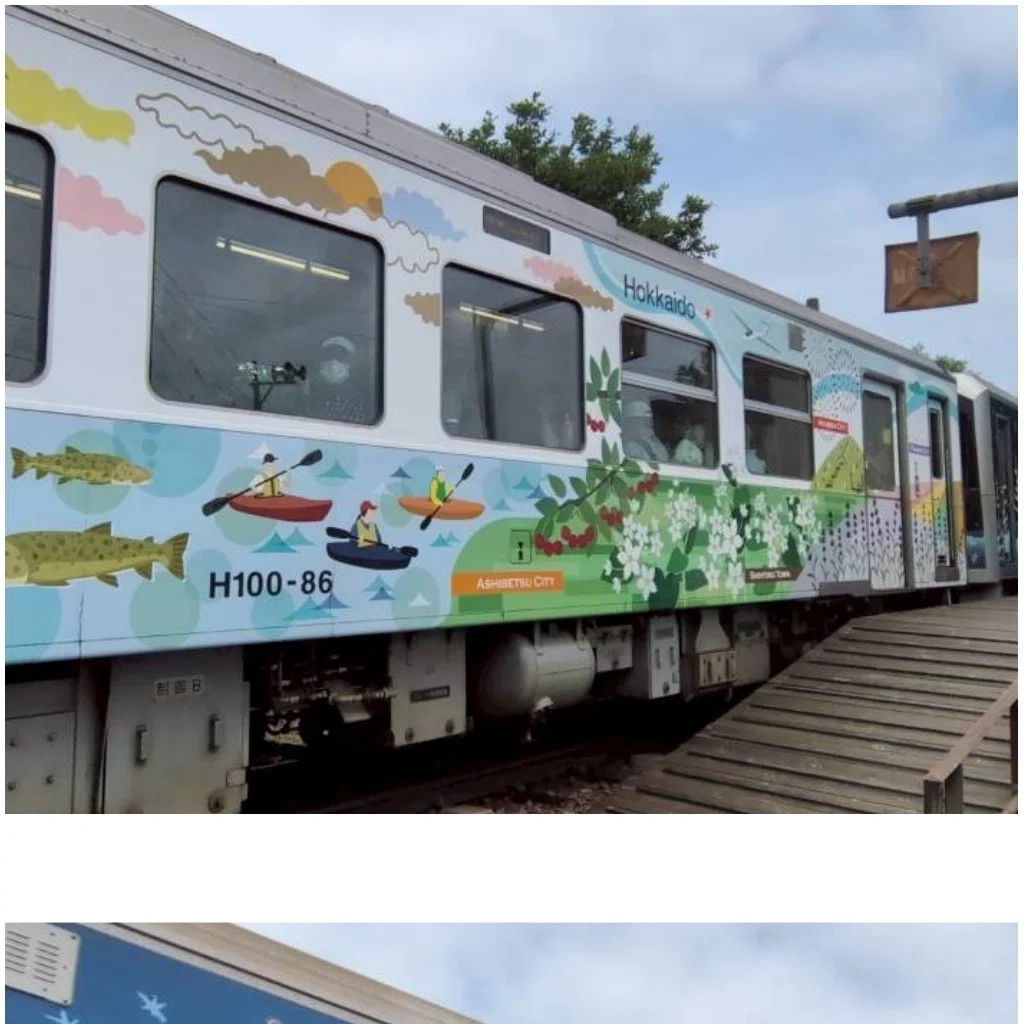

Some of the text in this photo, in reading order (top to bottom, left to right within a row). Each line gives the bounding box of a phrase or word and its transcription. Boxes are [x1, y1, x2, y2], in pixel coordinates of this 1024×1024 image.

[623, 274, 695, 319] Hokkaido
[209, 570, 333, 598] H100-86
[476, 576, 556, 590] ASHIBETSU CITY
